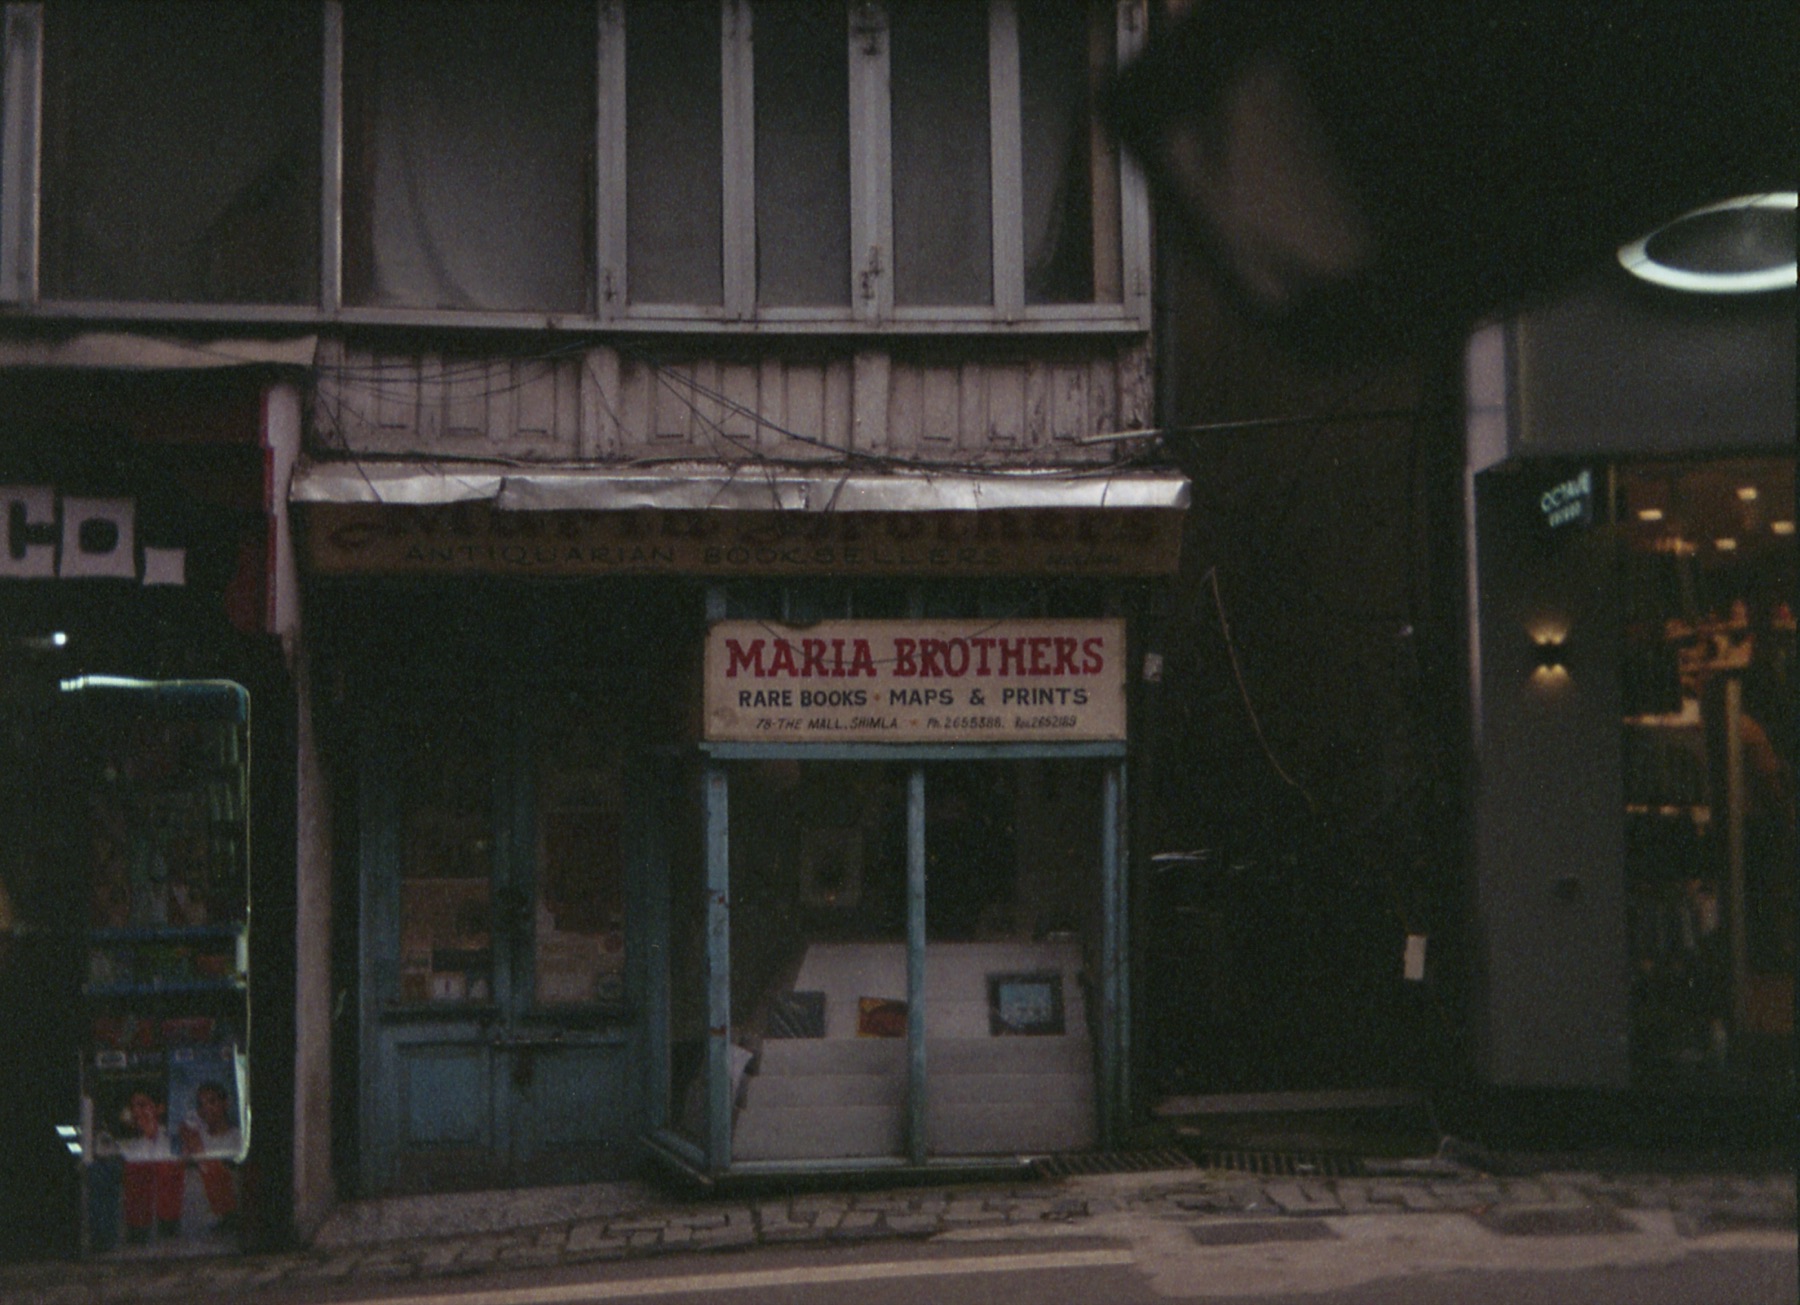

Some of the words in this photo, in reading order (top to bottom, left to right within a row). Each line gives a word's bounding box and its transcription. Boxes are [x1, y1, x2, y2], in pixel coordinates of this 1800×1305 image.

[406, 545, 676, 566] ANTIQUARIAN
[726, 638, 877, 678] MARIA
[893, 636, 1104, 677] BROTHERS
[738, 689, 793, 708] RARE
[800, 689, 867, 708] BOOKS
[890, 688, 954, 706] MAPS
[970, 689, 985, 706] &
[1002, 687, 1088, 706] PRINTS
